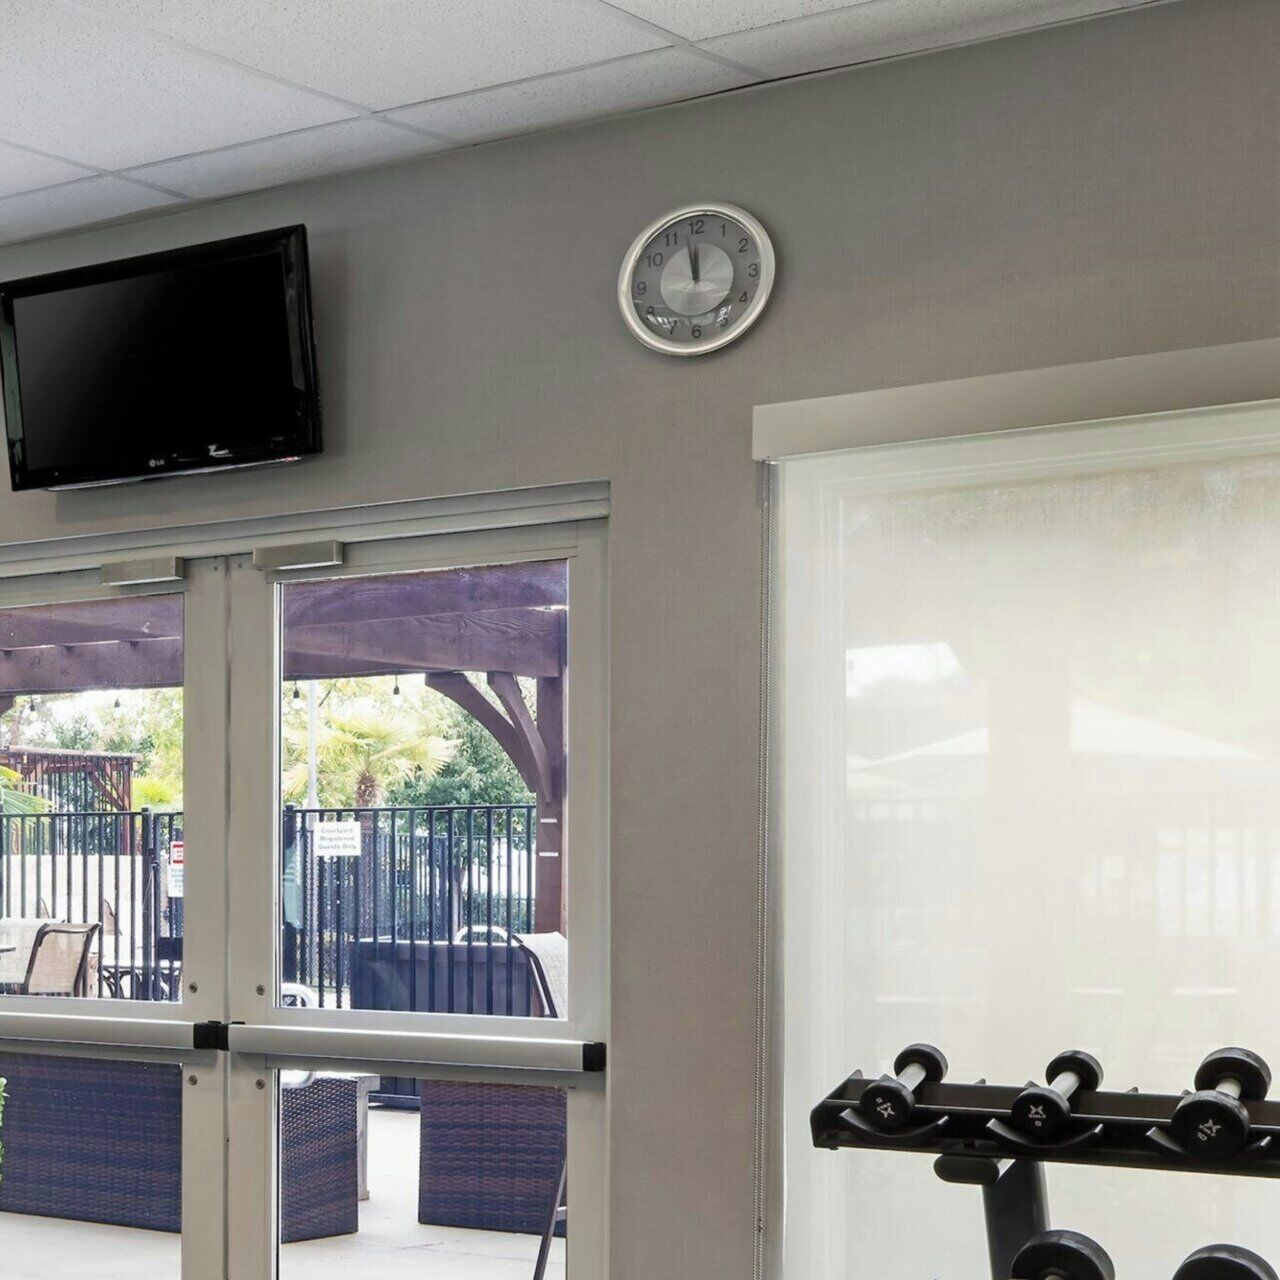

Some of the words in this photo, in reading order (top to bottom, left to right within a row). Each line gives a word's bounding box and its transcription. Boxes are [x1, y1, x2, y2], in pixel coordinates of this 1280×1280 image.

[690, 220, 705, 235] 12
[720, 224, 726, 237] 1
[665, 233, 678, 247] 11
[739, 238, 749, 253] 2
[646, 252, 663, 268] 10
[748, 263, 758, 278] 3
[637, 281, 647, 295] 9
[739, 291, 748, 303] 4
[692, 325, 702, 339] 6
